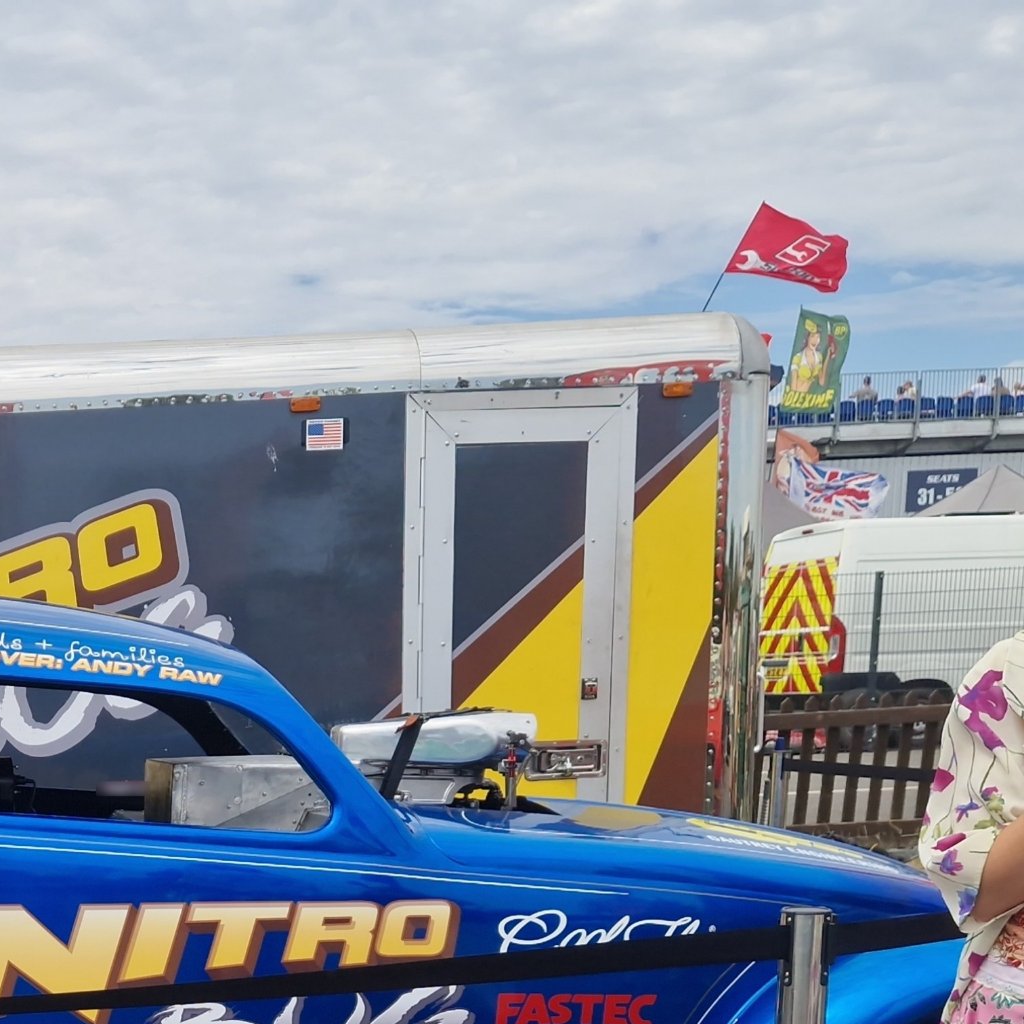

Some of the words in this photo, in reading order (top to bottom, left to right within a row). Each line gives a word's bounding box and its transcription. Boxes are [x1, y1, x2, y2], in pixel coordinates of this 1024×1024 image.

[926, 473, 960, 484] SEATS
[917, 487, 935, 506] 31
[64, 641, 185, 667] families
[70, 656, 154, 677] ANDY
[158, 666, 222, 686] RAW
